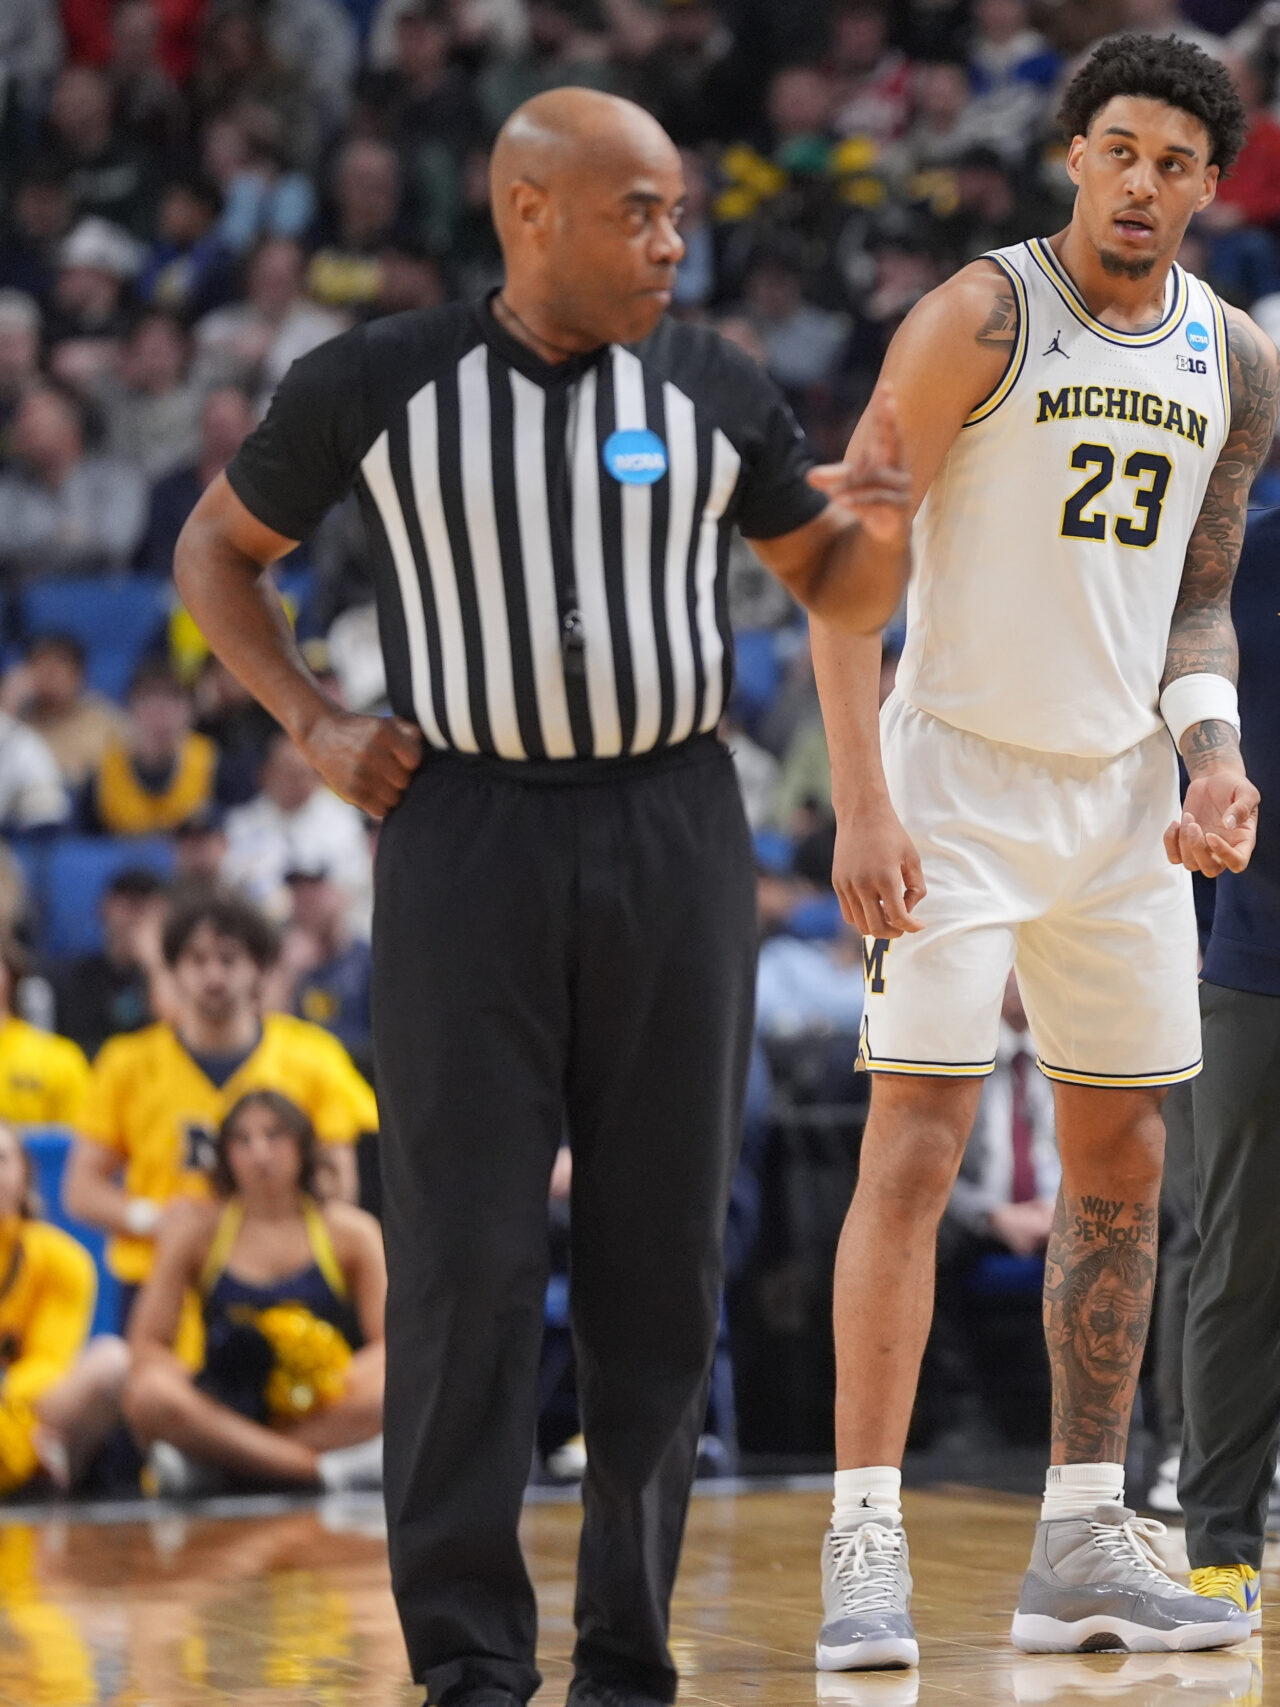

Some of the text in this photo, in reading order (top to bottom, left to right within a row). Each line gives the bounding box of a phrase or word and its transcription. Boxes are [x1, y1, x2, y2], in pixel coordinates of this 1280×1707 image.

[1034, 385, 1208, 449] MICHIGAN
[1058, 440, 1174, 550] 23
[1080, 1194, 1125, 1224] WHY
